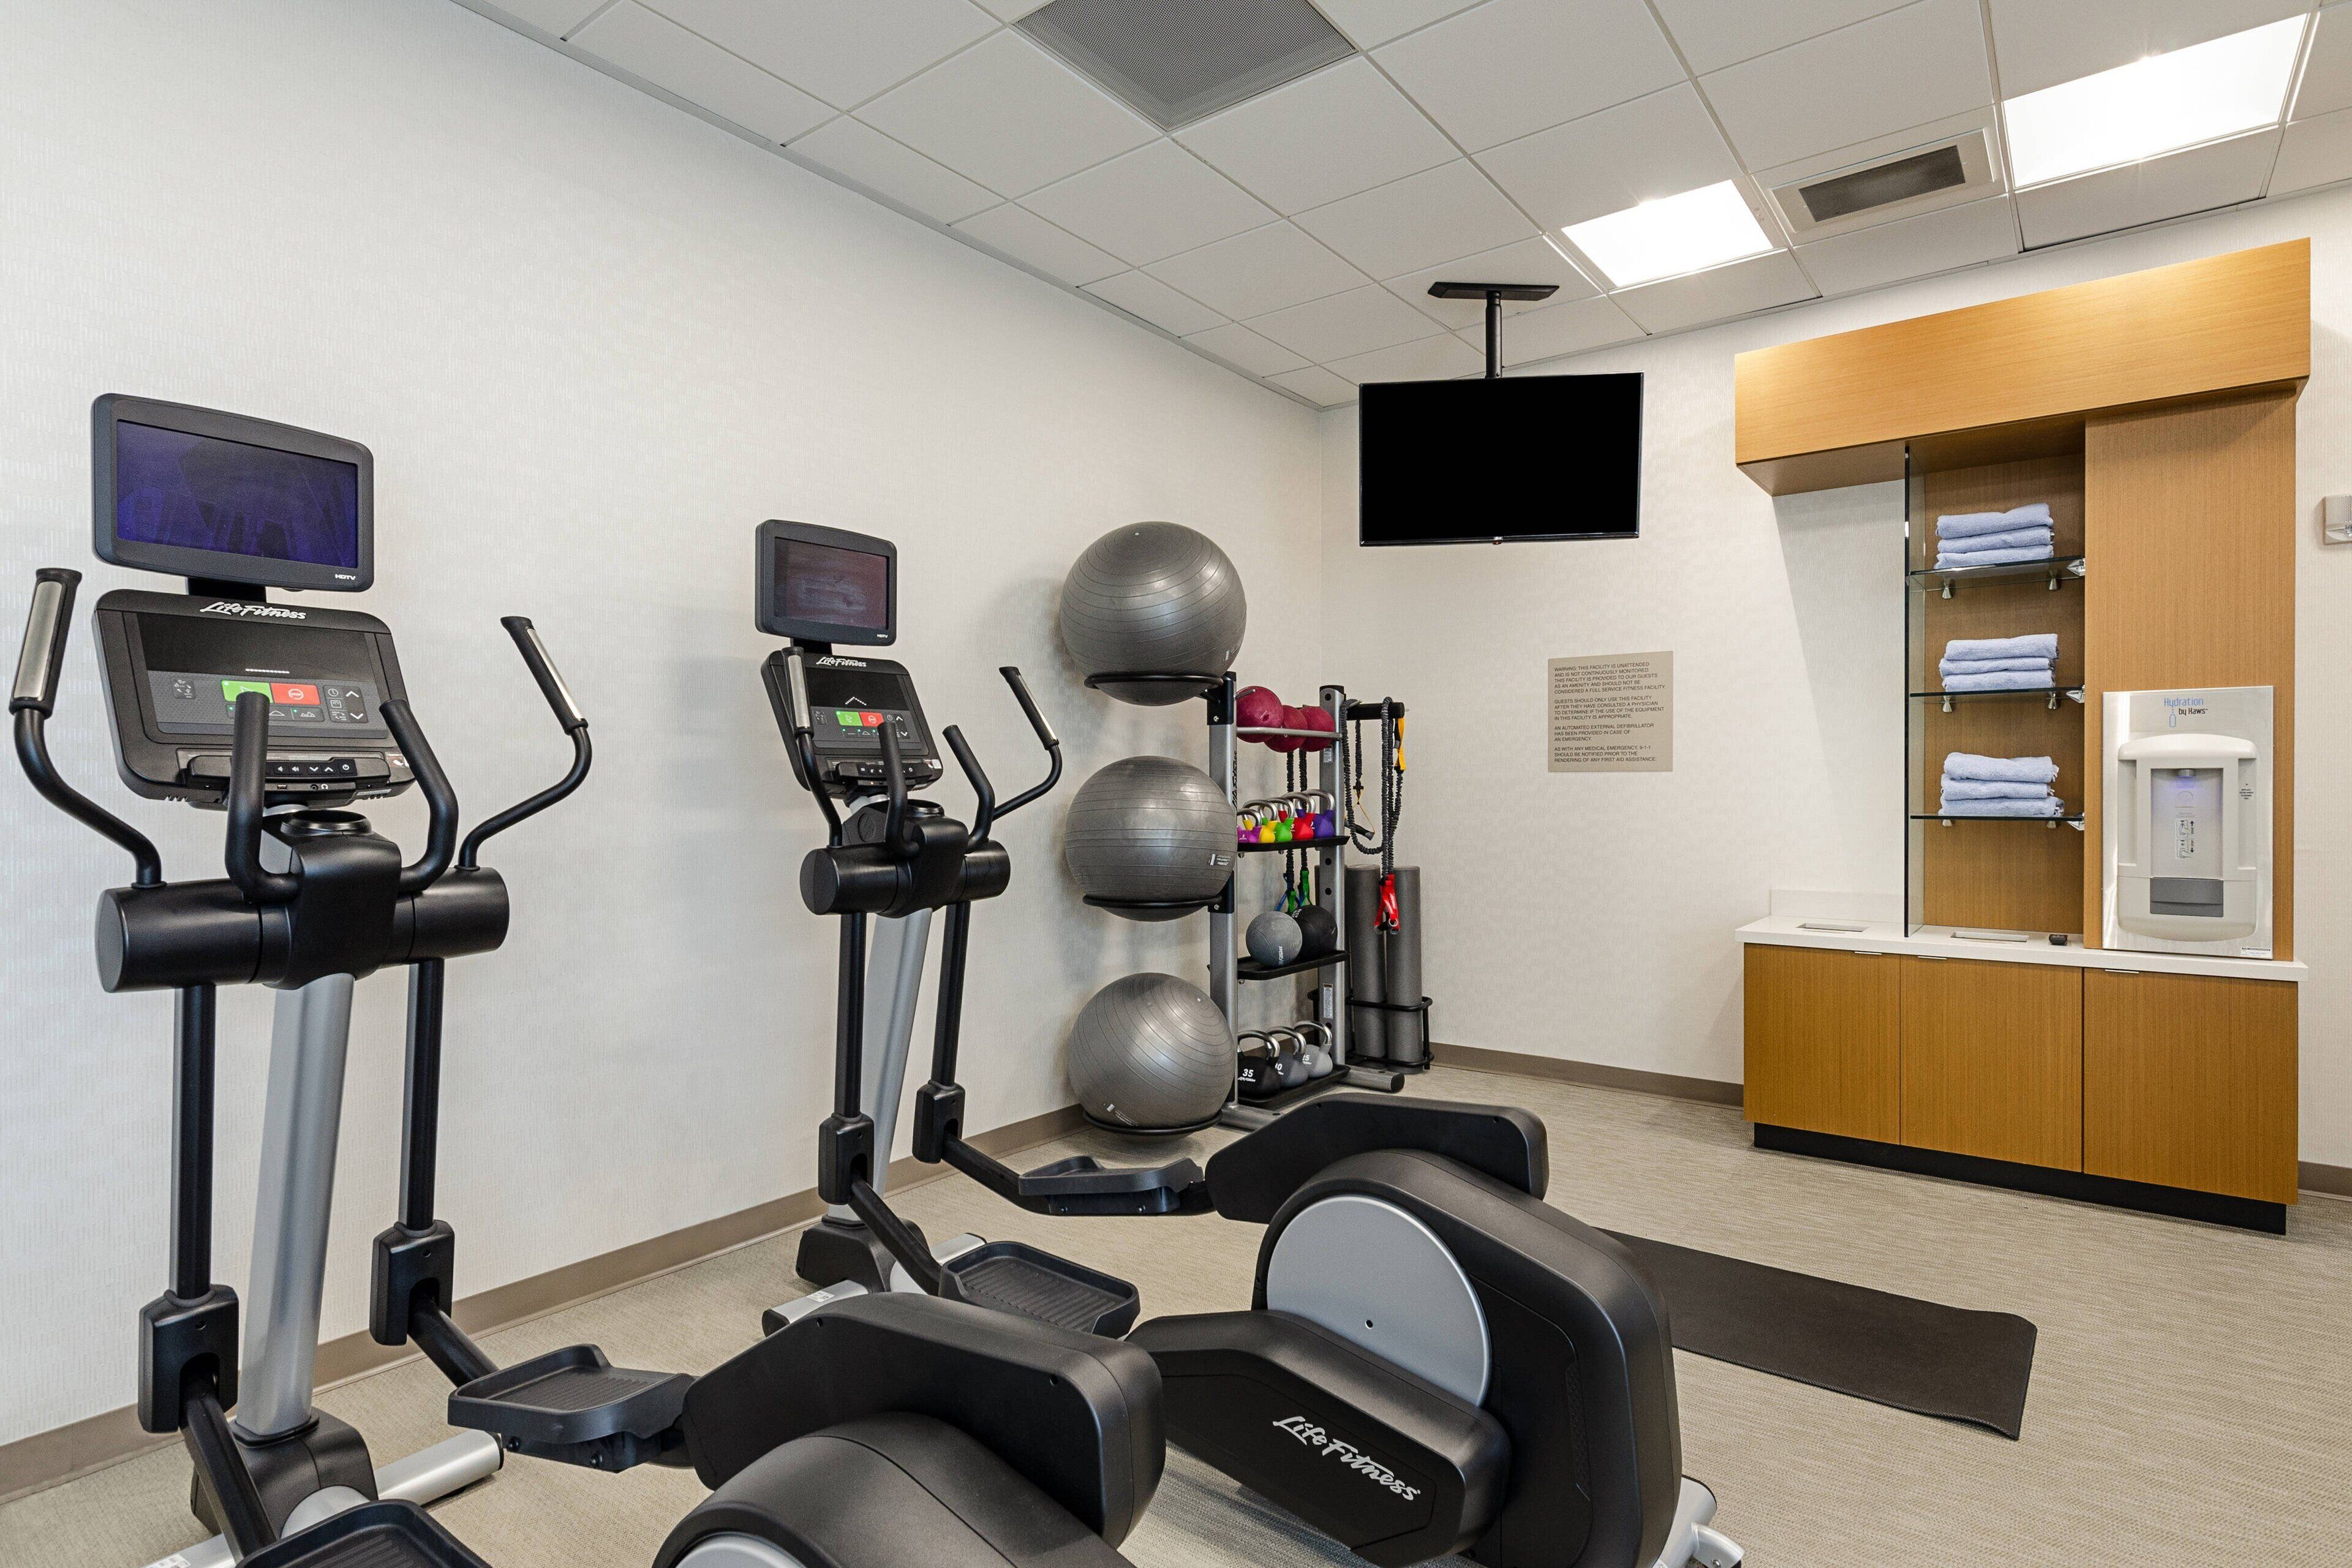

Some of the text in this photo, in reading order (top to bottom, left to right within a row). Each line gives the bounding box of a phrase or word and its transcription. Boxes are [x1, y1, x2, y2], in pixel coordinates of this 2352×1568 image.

[200, 601, 307, 619] Life Fitness
[816, 657, 867, 668] Life Fitness
[2164, 697, 2204, 708] Hydration
[1242, 1068, 1254, 1077] 35
[1273, 1415, 1420, 1501] Life Fitness
